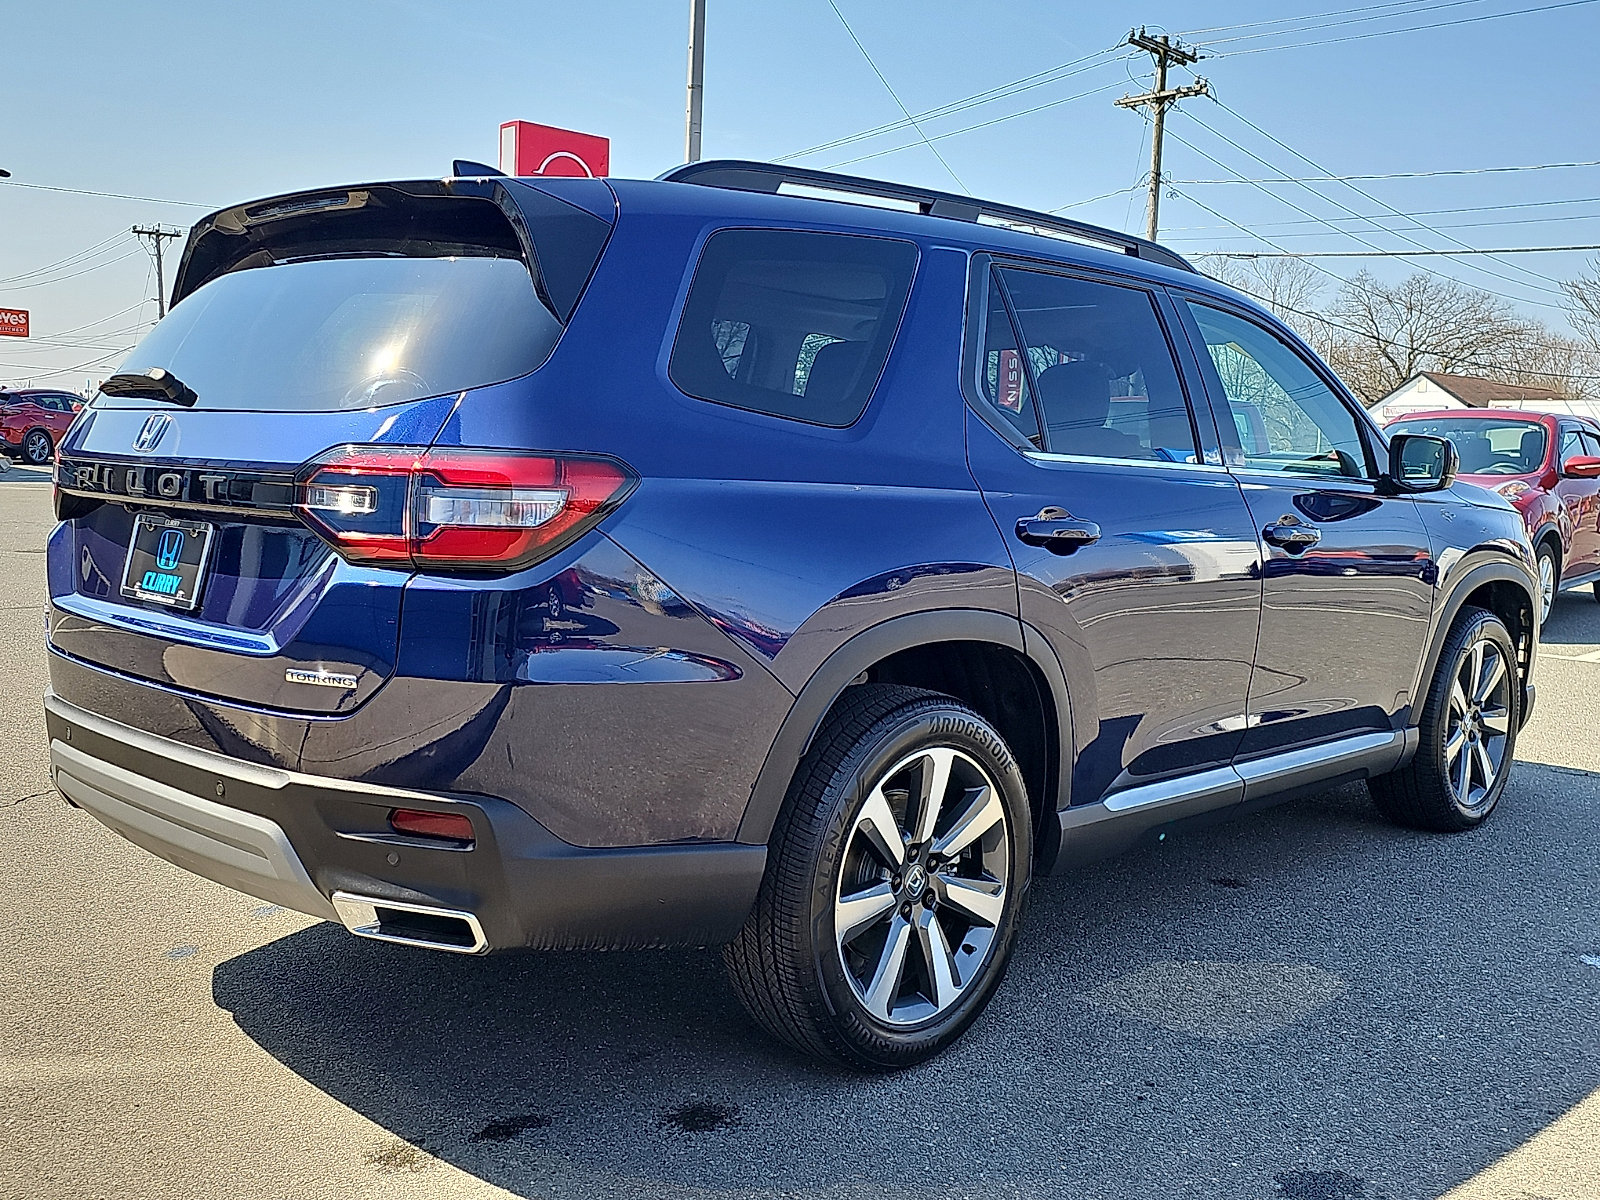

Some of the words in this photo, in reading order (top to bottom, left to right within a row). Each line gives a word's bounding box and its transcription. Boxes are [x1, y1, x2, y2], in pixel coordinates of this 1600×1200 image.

[77, 466, 227, 500] PILOT
[141, 571, 183, 594] CURRY
[287, 671, 354, 687] TOURING
[928, 715, 1015, 775] BRIDGESTONE
[816, 798, 855, 897] ALENZA
